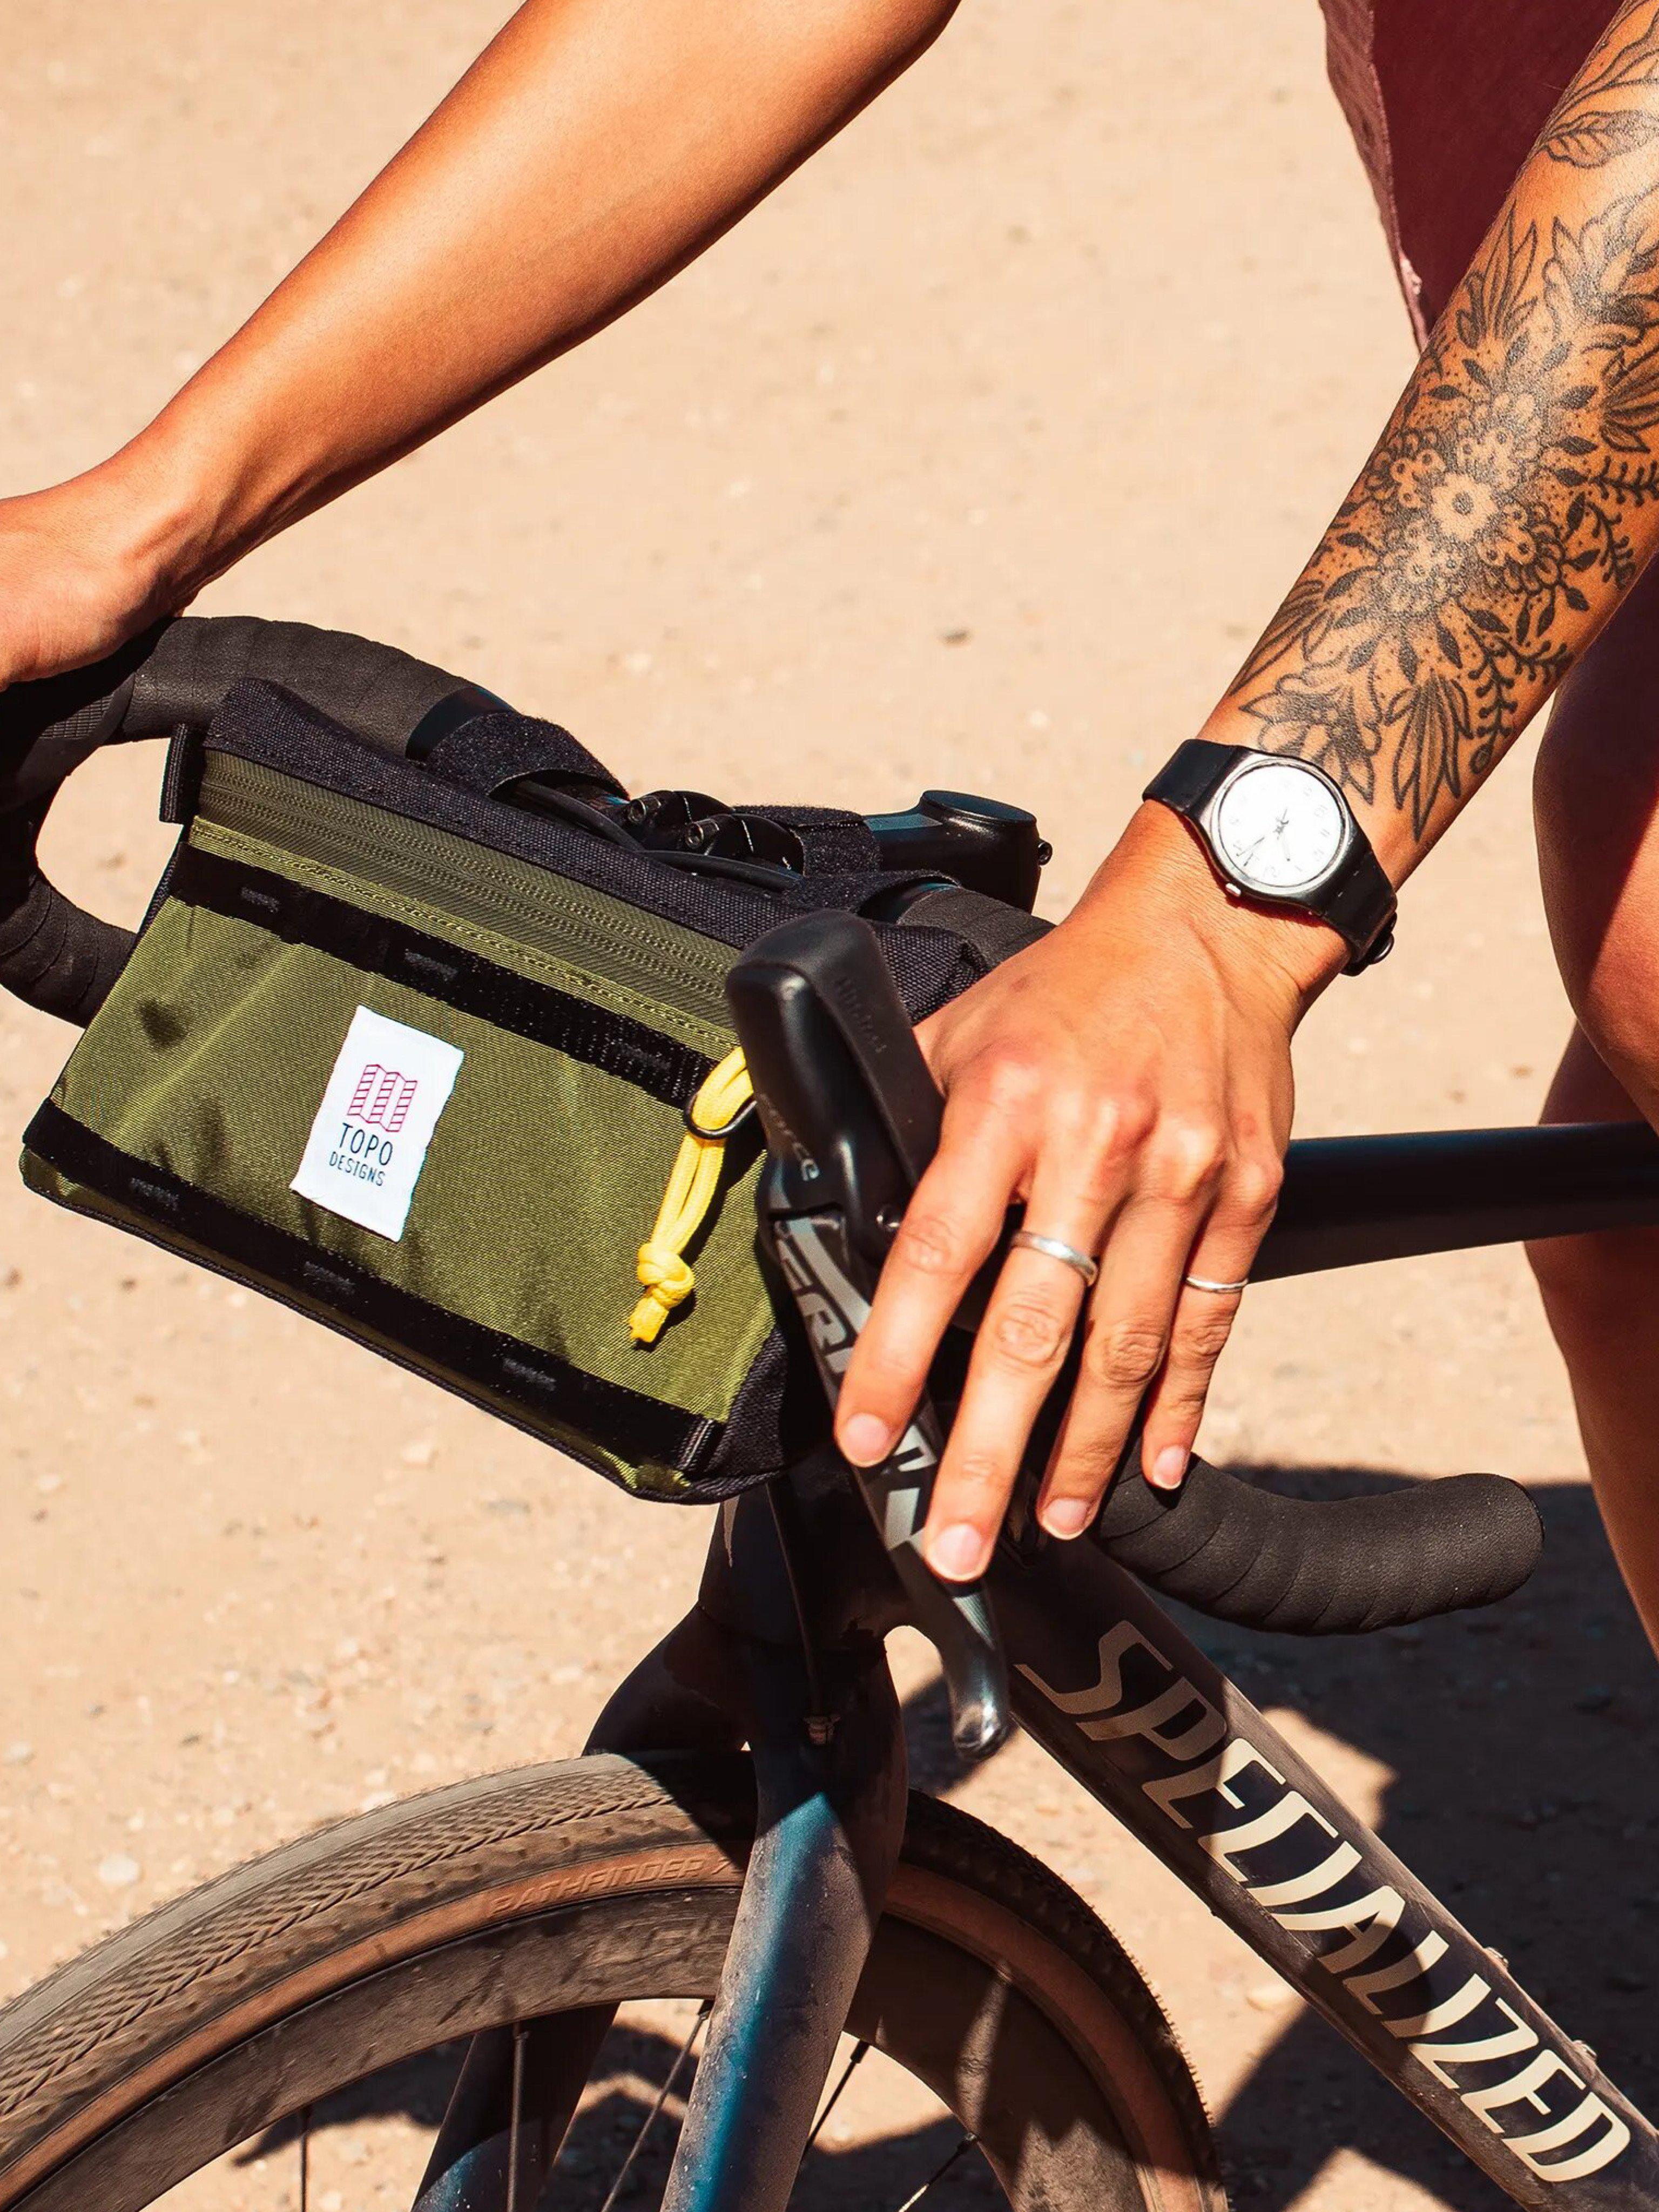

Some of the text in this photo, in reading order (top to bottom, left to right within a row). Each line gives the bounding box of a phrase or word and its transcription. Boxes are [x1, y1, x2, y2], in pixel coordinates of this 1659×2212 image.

[329, 1151, 386, 1186] DESIGNS
[339, 1123, 393, 1165] TOPO
[490, 1857, 705, 1914] PATHFINDER
[1013, 1620, 1631, 2182] SPECIALIZED
